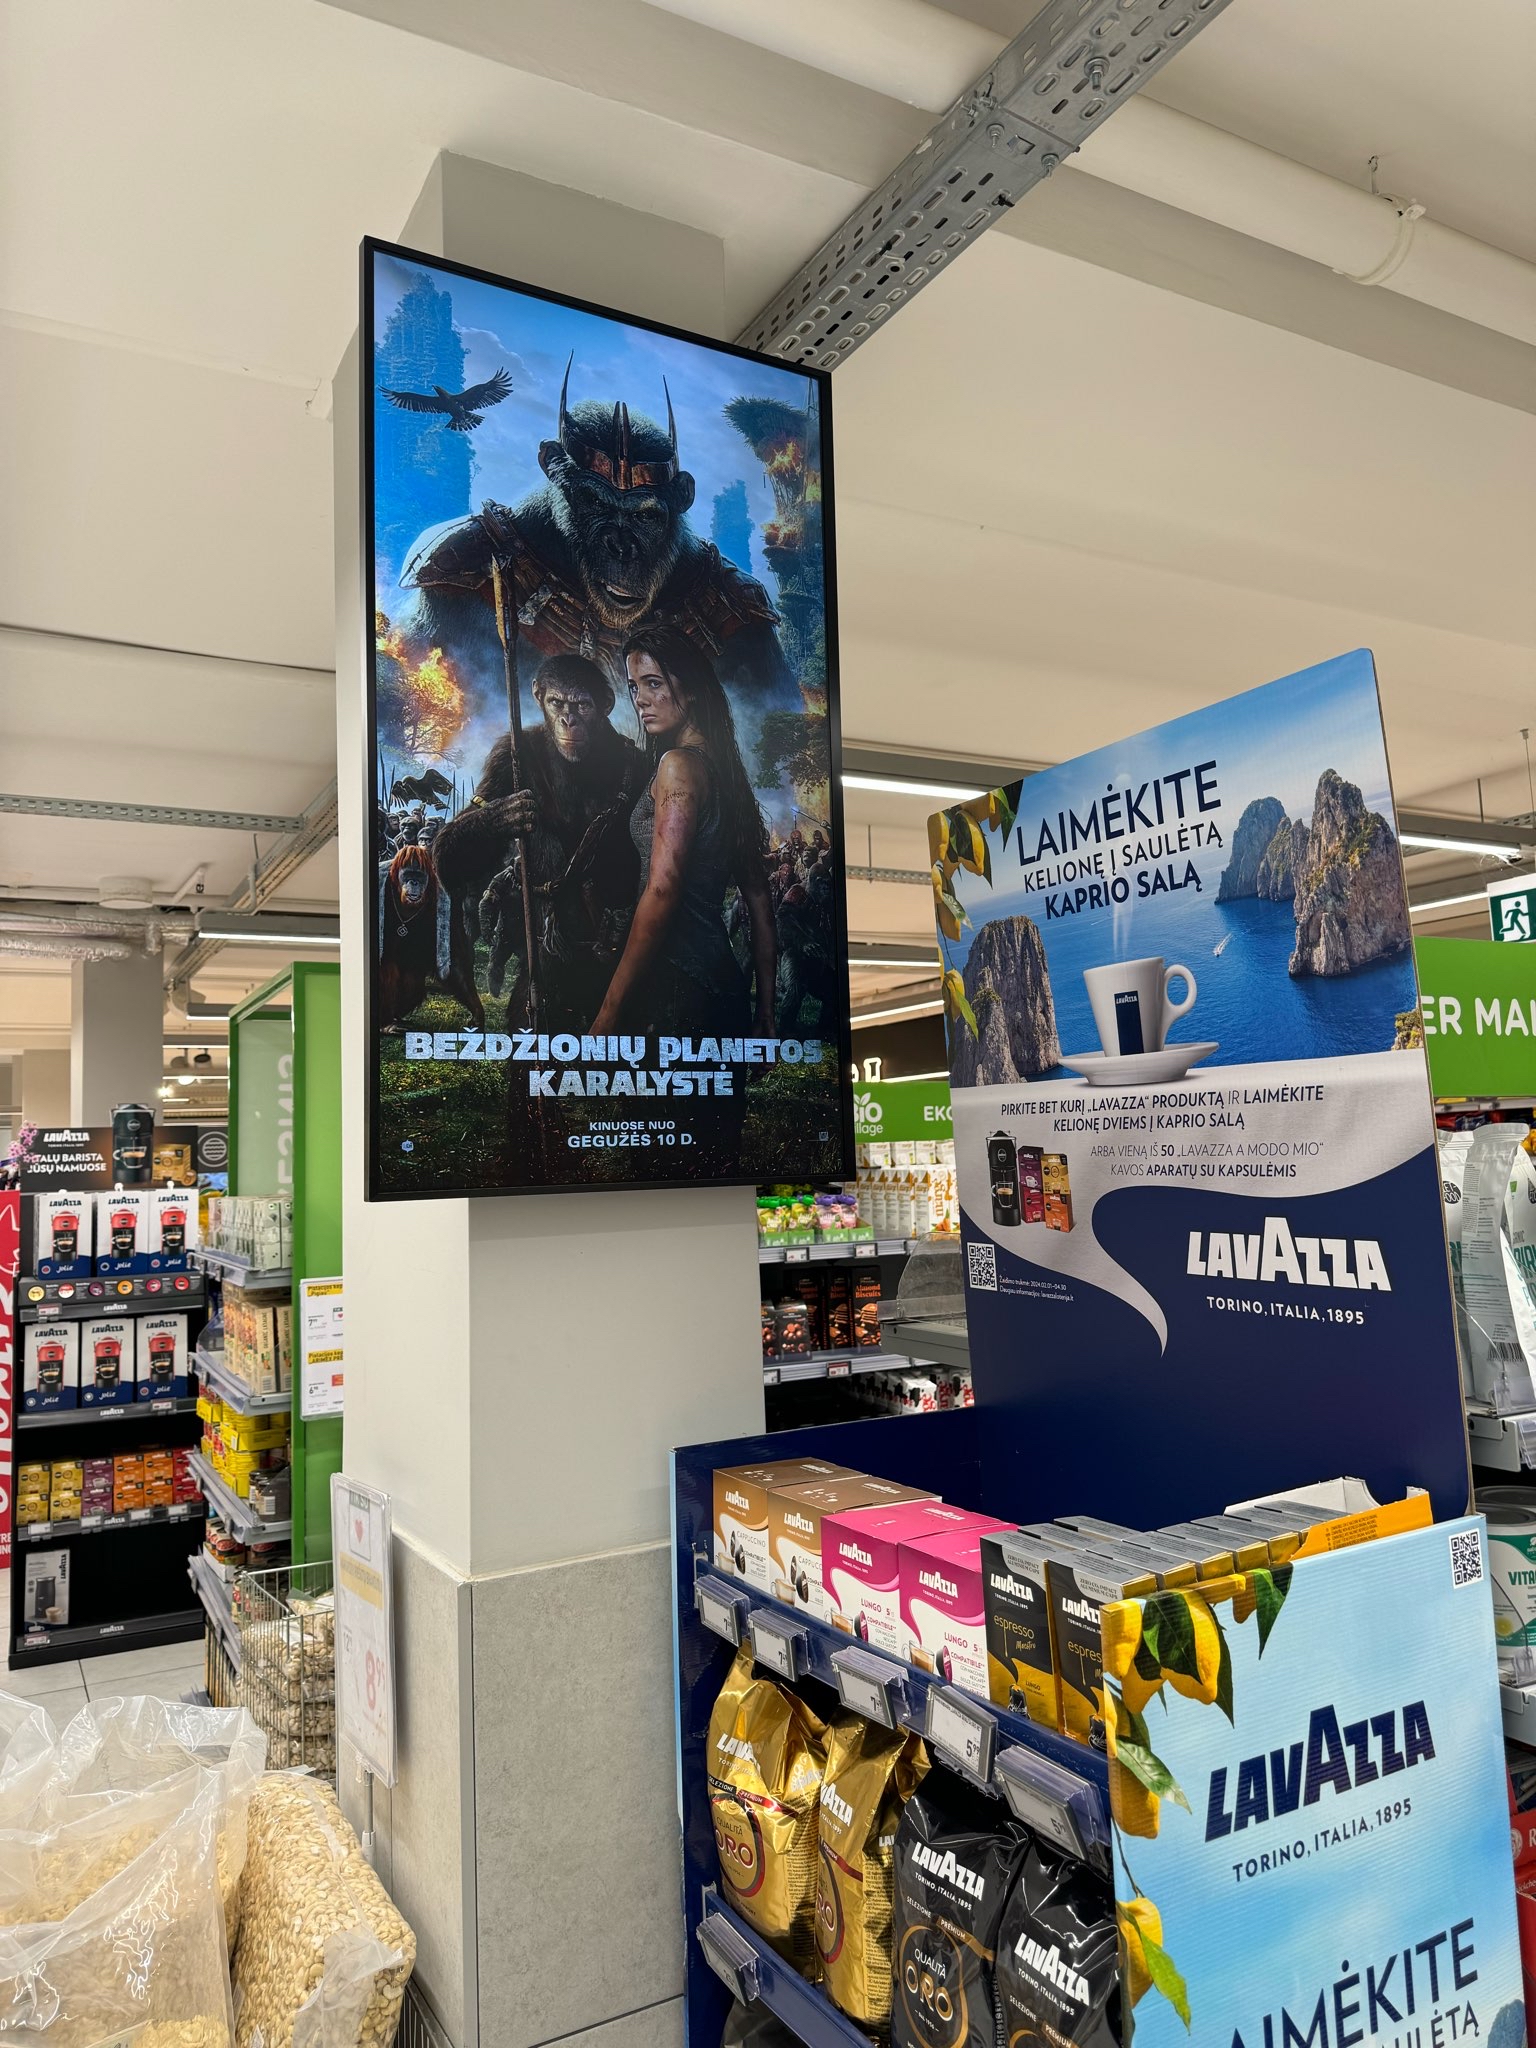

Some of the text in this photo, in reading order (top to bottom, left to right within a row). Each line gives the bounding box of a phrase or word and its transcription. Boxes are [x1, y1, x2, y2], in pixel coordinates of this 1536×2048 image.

[1017, 760, 1221, 866] LAIMĖKITE
[1024, 820, 1223, 894] KELIONĘ Į SAULĖTĄ
[1045, 859, 1203, 920] KAPRIO SALĄ
[405, 1027, 823, 1068] BEŽDŽIONIŲ PLANETOS
[529, 1064, 734, 1096] KARALYSTĖ
[1001, 1102, 1036, 1115] PIRKITE
[1039, 1101, 1058, 1113] BET
[1060, 1099, 1085, 1115] KURĮ
[1152, 1092, 1225, 1109] PRODUKTĄ
[1228, 1090, 1240, 1105] IR
[1244, 1084, 1324, 1104] LAIMĖKITE
[589, 1120, 676, 1131] KINUOSE NUO
[855, 1123, 884, 1136] illage
[1054, 1112, 1245, 1134] KELIONĘ DVIEMS Į KAPRIO SALĄ
[43, 1130, 90, 1143] LAVAZZA
[567, 1132, 697, 1148] GEGUŽĖS 10 D.
[62, 1153, 104, 1162] BARISTA
[1090, 1145, 1115, 1157] ARBA
[1117, 1145, 1148, 1159] VIENĄ
[1150, 1142, 1158, 1157] IŠ
[1160, 1144, 1175, 1157] 50
[1235, 1143, 1245, 1156] A
[1247, 1142, 1290, 1157] MODO
[56, 1163, 107, 1173] NAMUOSE
[1111, 1161, 1297, 1179] KAVOS APARATŲ SU KAPSULĖMIS
[50, 1198, 82, 1207] LAVAZZA
[108, 1196, 140, 1205] LAVAZZA
[158, 1194, 190, 1203] LAVAZZA
[1187, 1216, 1392, 1292] LAVAZZA
[1207, 1296, 1364, 1325] TORINO, ITALIA, 1895
[35, 1328, 68, 1338] LAVAZZA
[91, 1324, 125, 1334] LAVAZZA
[146, 1319, 178, 1329] LAVAZZA
[725, 1490, 750, 1511] LAVAZZA
[784, 1512, 815, 1534] LAVAZZA
[839, 1542, 873, 1567] LAVAZZA
[919, 1570, 959, 1599] LAVAZZA
[991, 1573, 1034, 1602] LAVAZZA
[861, 1598, 882, 1613] LUNGO
[994, 1614, 1035, 1641] espresso
[944, 1631, 968, 1649] LUNGO
[1067, 1641, 1102, 1663] espres
[1205, 1700, 1436, 1843] LAVAZZA
[716, 1816, 743, 1837] QUALITÀ
[715, 1830, 754, 1868] ORO
[1232, 1798, 1412, 1882] TORINO, ITALIA, 1895
[912, 1842, 985, 1901] LAVAZZA
[958, 1898, 972, 1911] 1895
[907, 1895, 966, 1940] SELEZIONE PREMIUM
[914, 1948, 946, 1979] QUALITÀ
[1014, 1932, 1090, 2006] LAVAZZA
[905, 1959, 953, 2021] ORO
[1059, 2000, 1075, 2016] 1895
[1010, 1995, 1072, 2048] SELEZIONE PREMIUM
